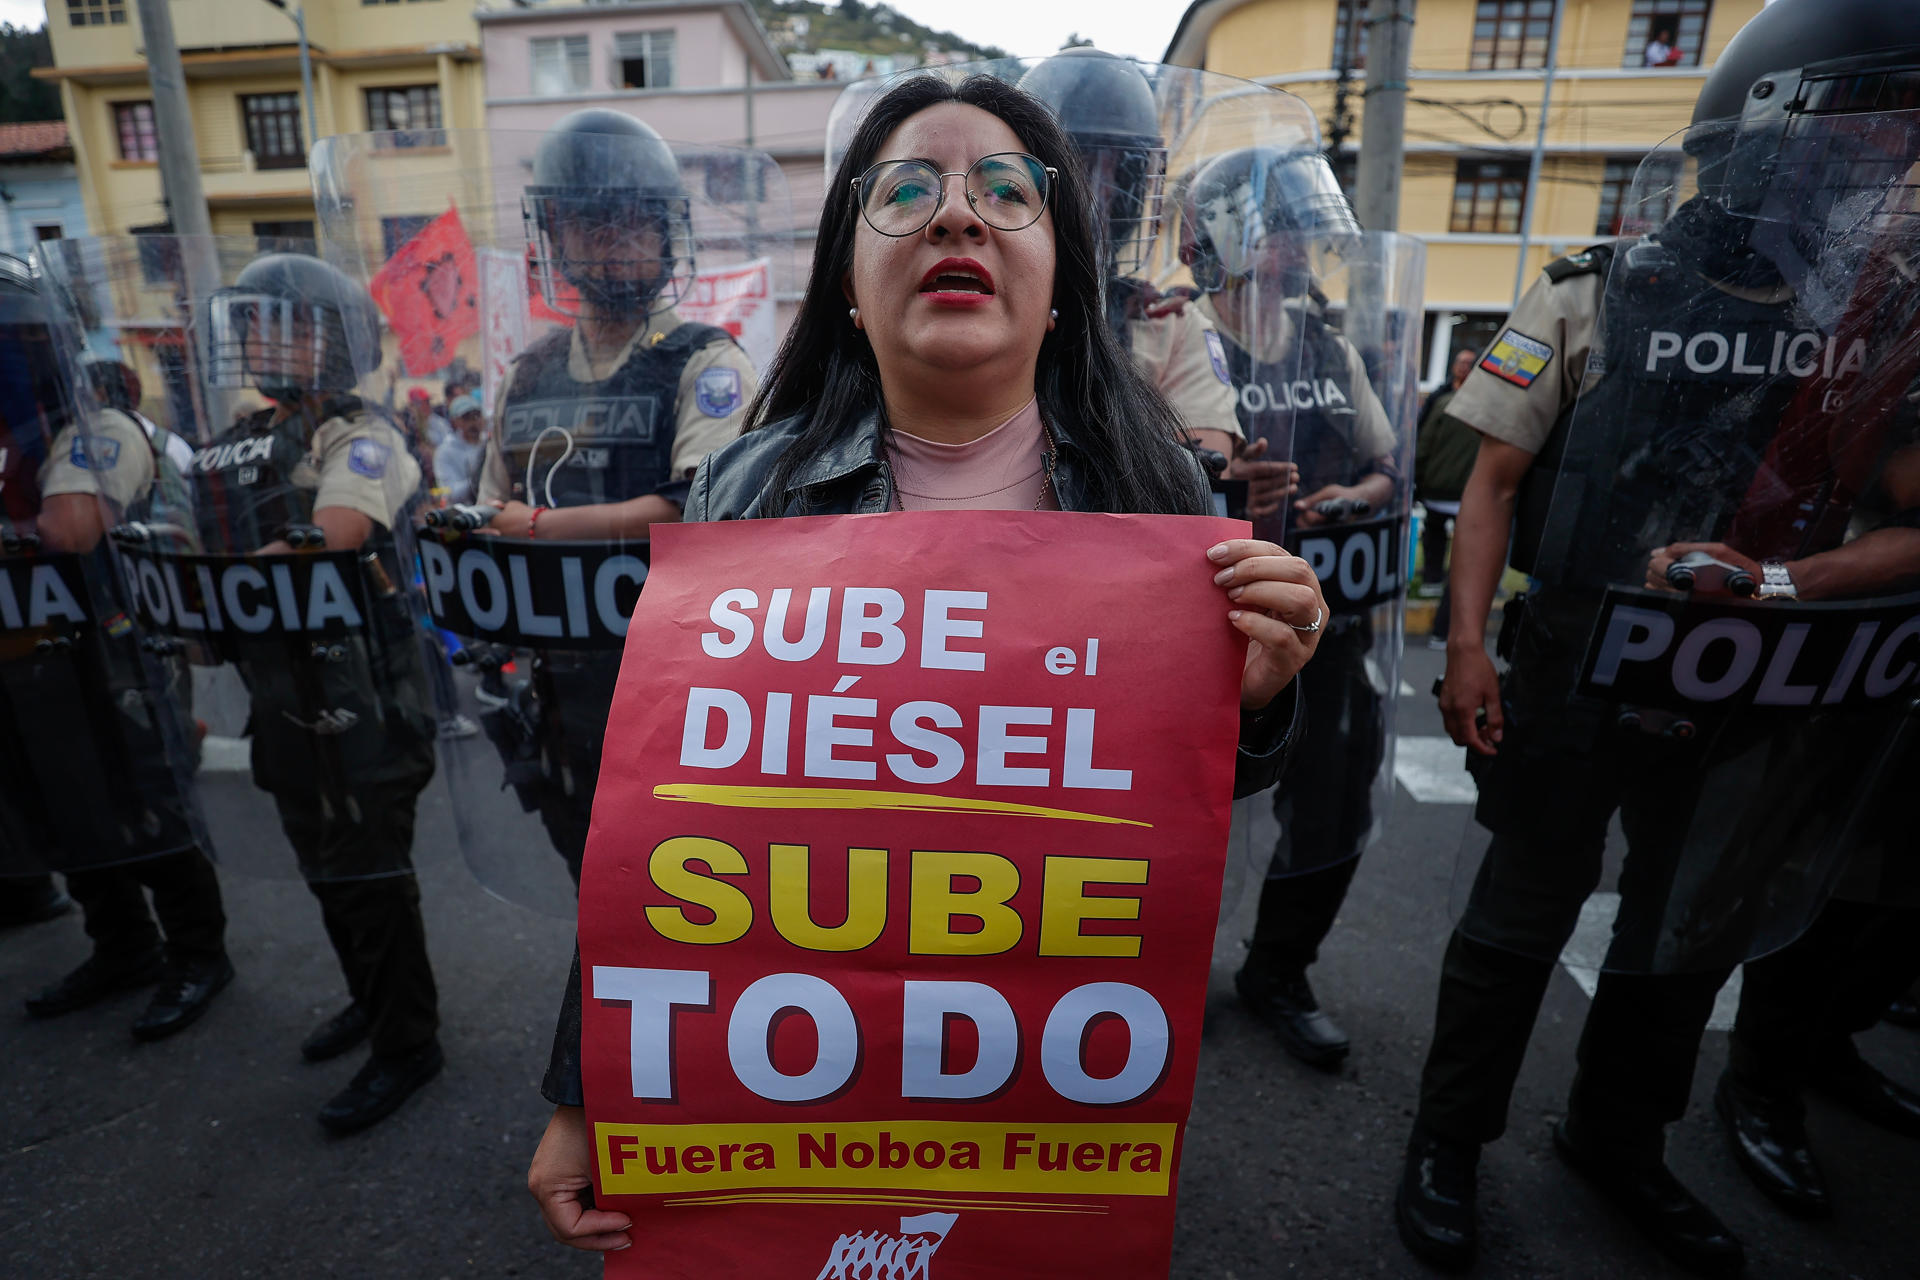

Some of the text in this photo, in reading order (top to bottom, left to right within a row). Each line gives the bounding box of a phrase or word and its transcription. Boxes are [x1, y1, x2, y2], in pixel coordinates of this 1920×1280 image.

[1645, 330, 1867, 381] POLICIA
[1232, 377, 1347, 413] OLICIA
[122, 555, 362, 633] POLICIA
[700, 586, 1098, 676] SUBE el
[679, 675, 1133, 791] DIÉSEL
[643, 835, 1150, 958] SUBE
[606, 1132, 1164, 1176] Fuera Noboa Fuera
